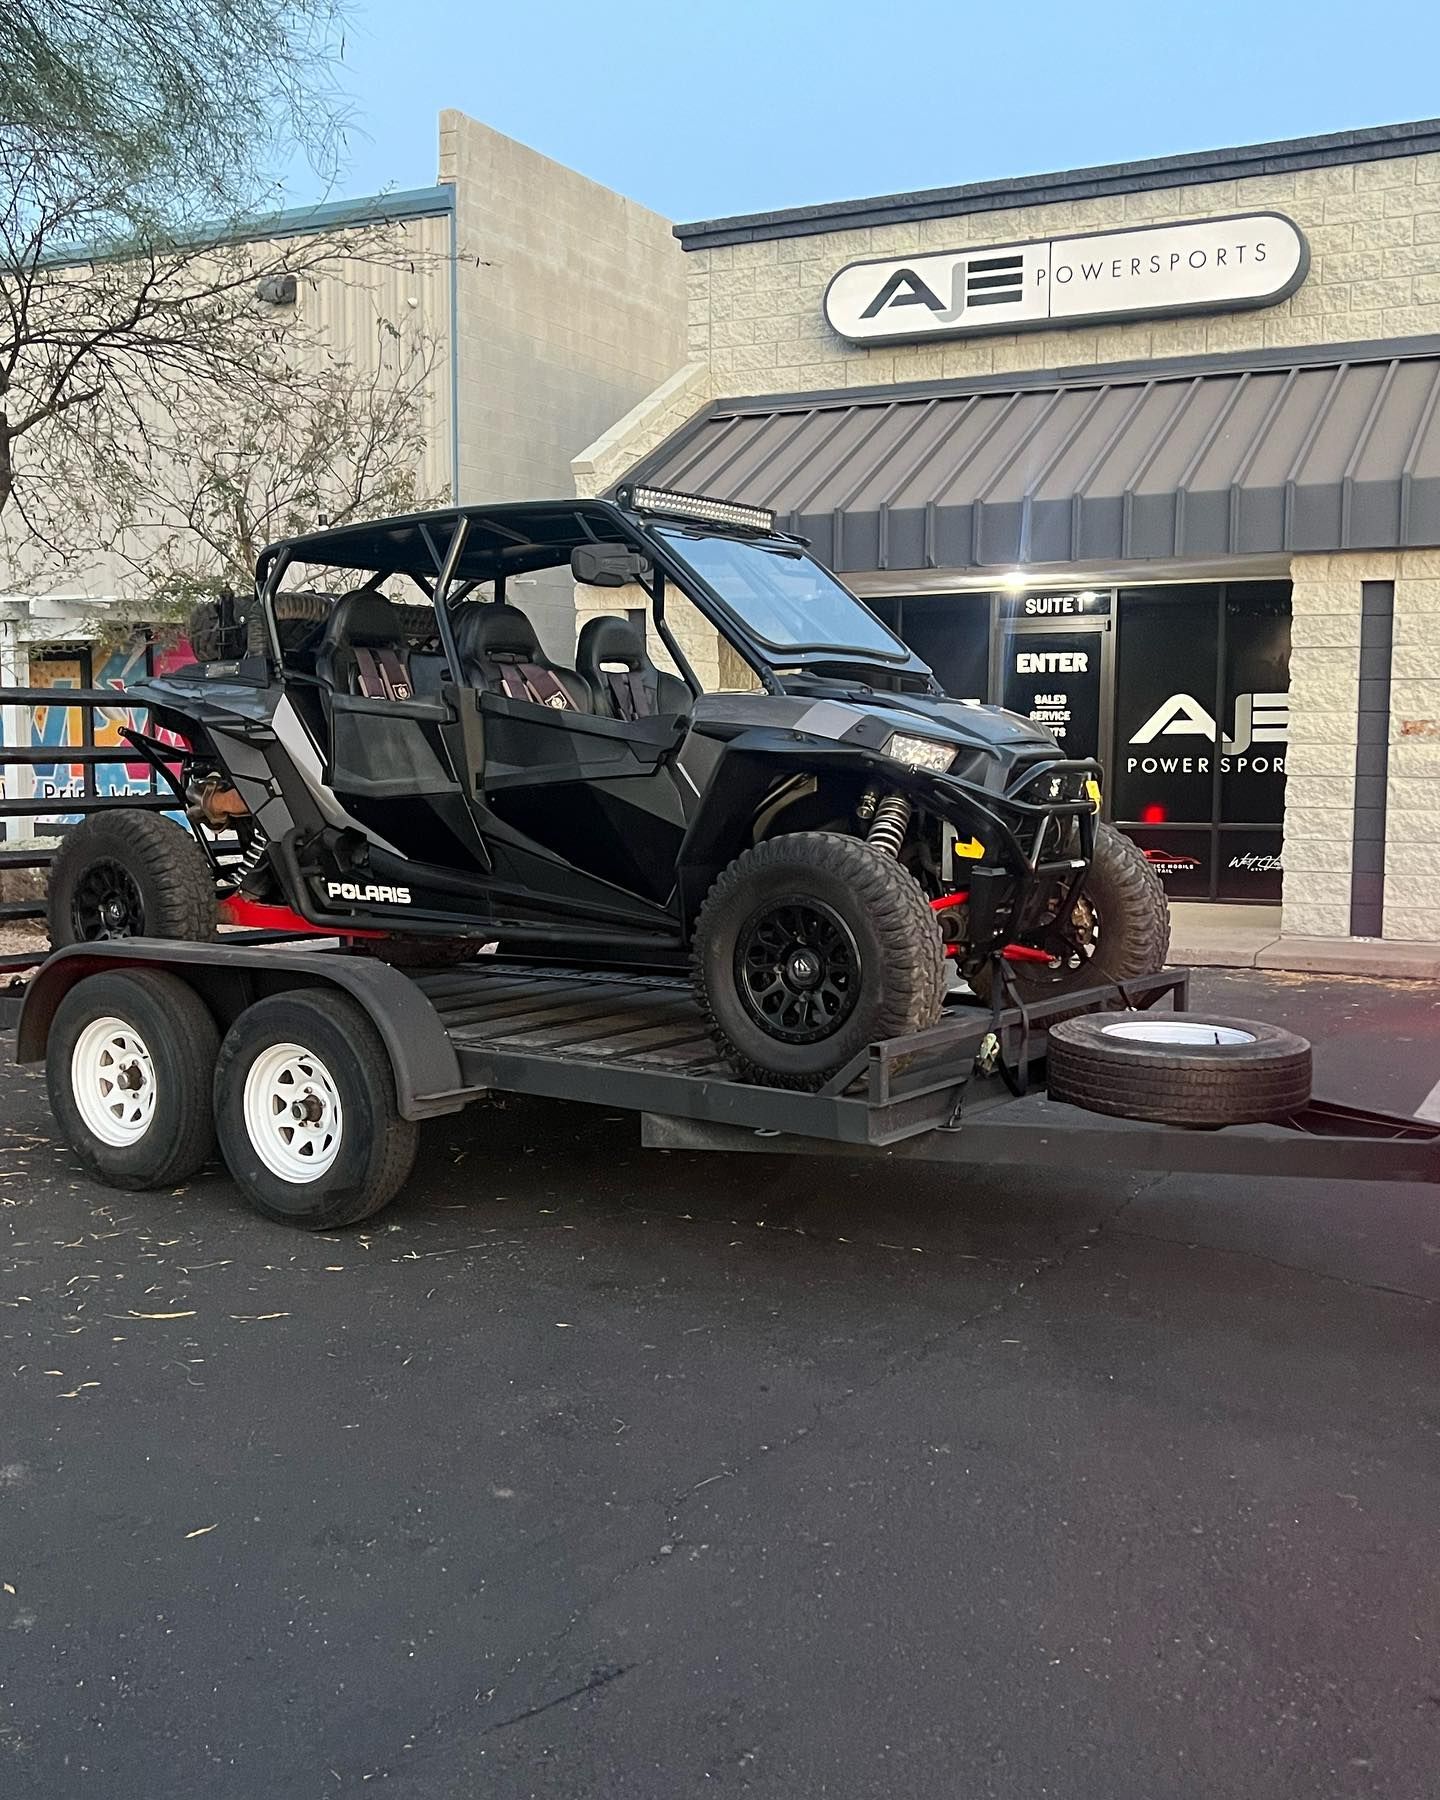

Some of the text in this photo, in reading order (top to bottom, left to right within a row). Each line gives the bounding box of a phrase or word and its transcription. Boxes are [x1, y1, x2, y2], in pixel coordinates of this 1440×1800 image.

[859, 242, 1267, 323] AJE POWERSPORTS
[1025, 598, 1073, 614] SUITE
[1016, 652, 1088, 673] ENTER
[1034, 694, 1067, 705] SALES
[1029, 710, 1071, 721] SERVICE
[1128, 693, 1289, 755] AJE
[1127, 757, 1284, 773] POWERSPOR
[327, 882, 412, 904] POLARIS
